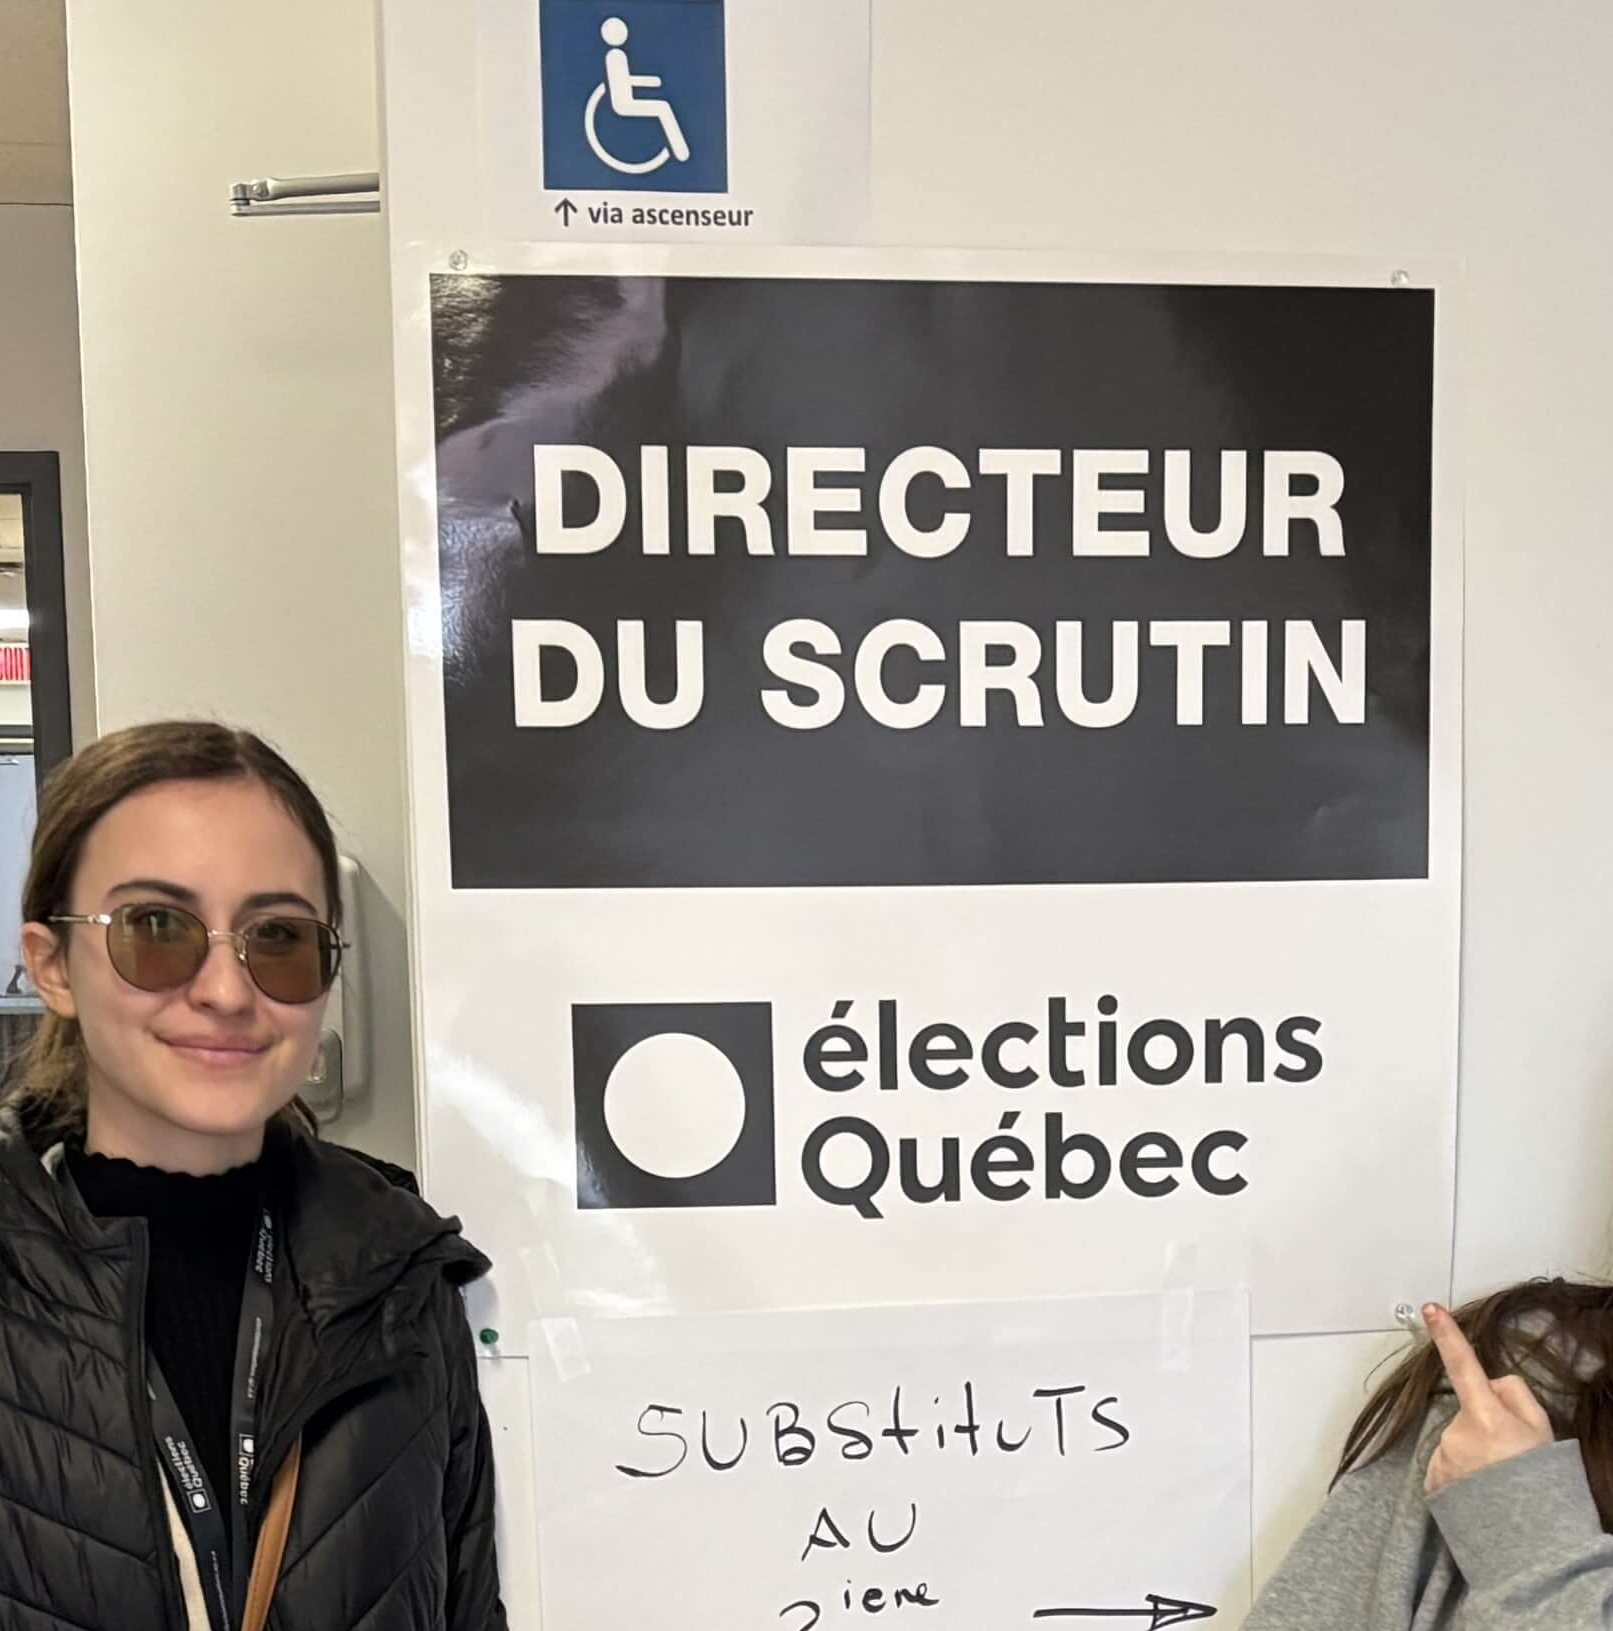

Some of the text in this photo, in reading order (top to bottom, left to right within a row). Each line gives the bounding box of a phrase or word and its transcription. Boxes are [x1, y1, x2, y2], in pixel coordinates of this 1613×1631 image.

[587, 204, 754, 229] via ascenseur
[533, 443, 1346, 559] DIRECTEUR
[511, 617, 1367, 730] DU SCRUTIN
[801, 994, 1323, 1093] élections
[800, 1110, 1249, 1219] Québec
[800, 1502, 917, 1563] AU
